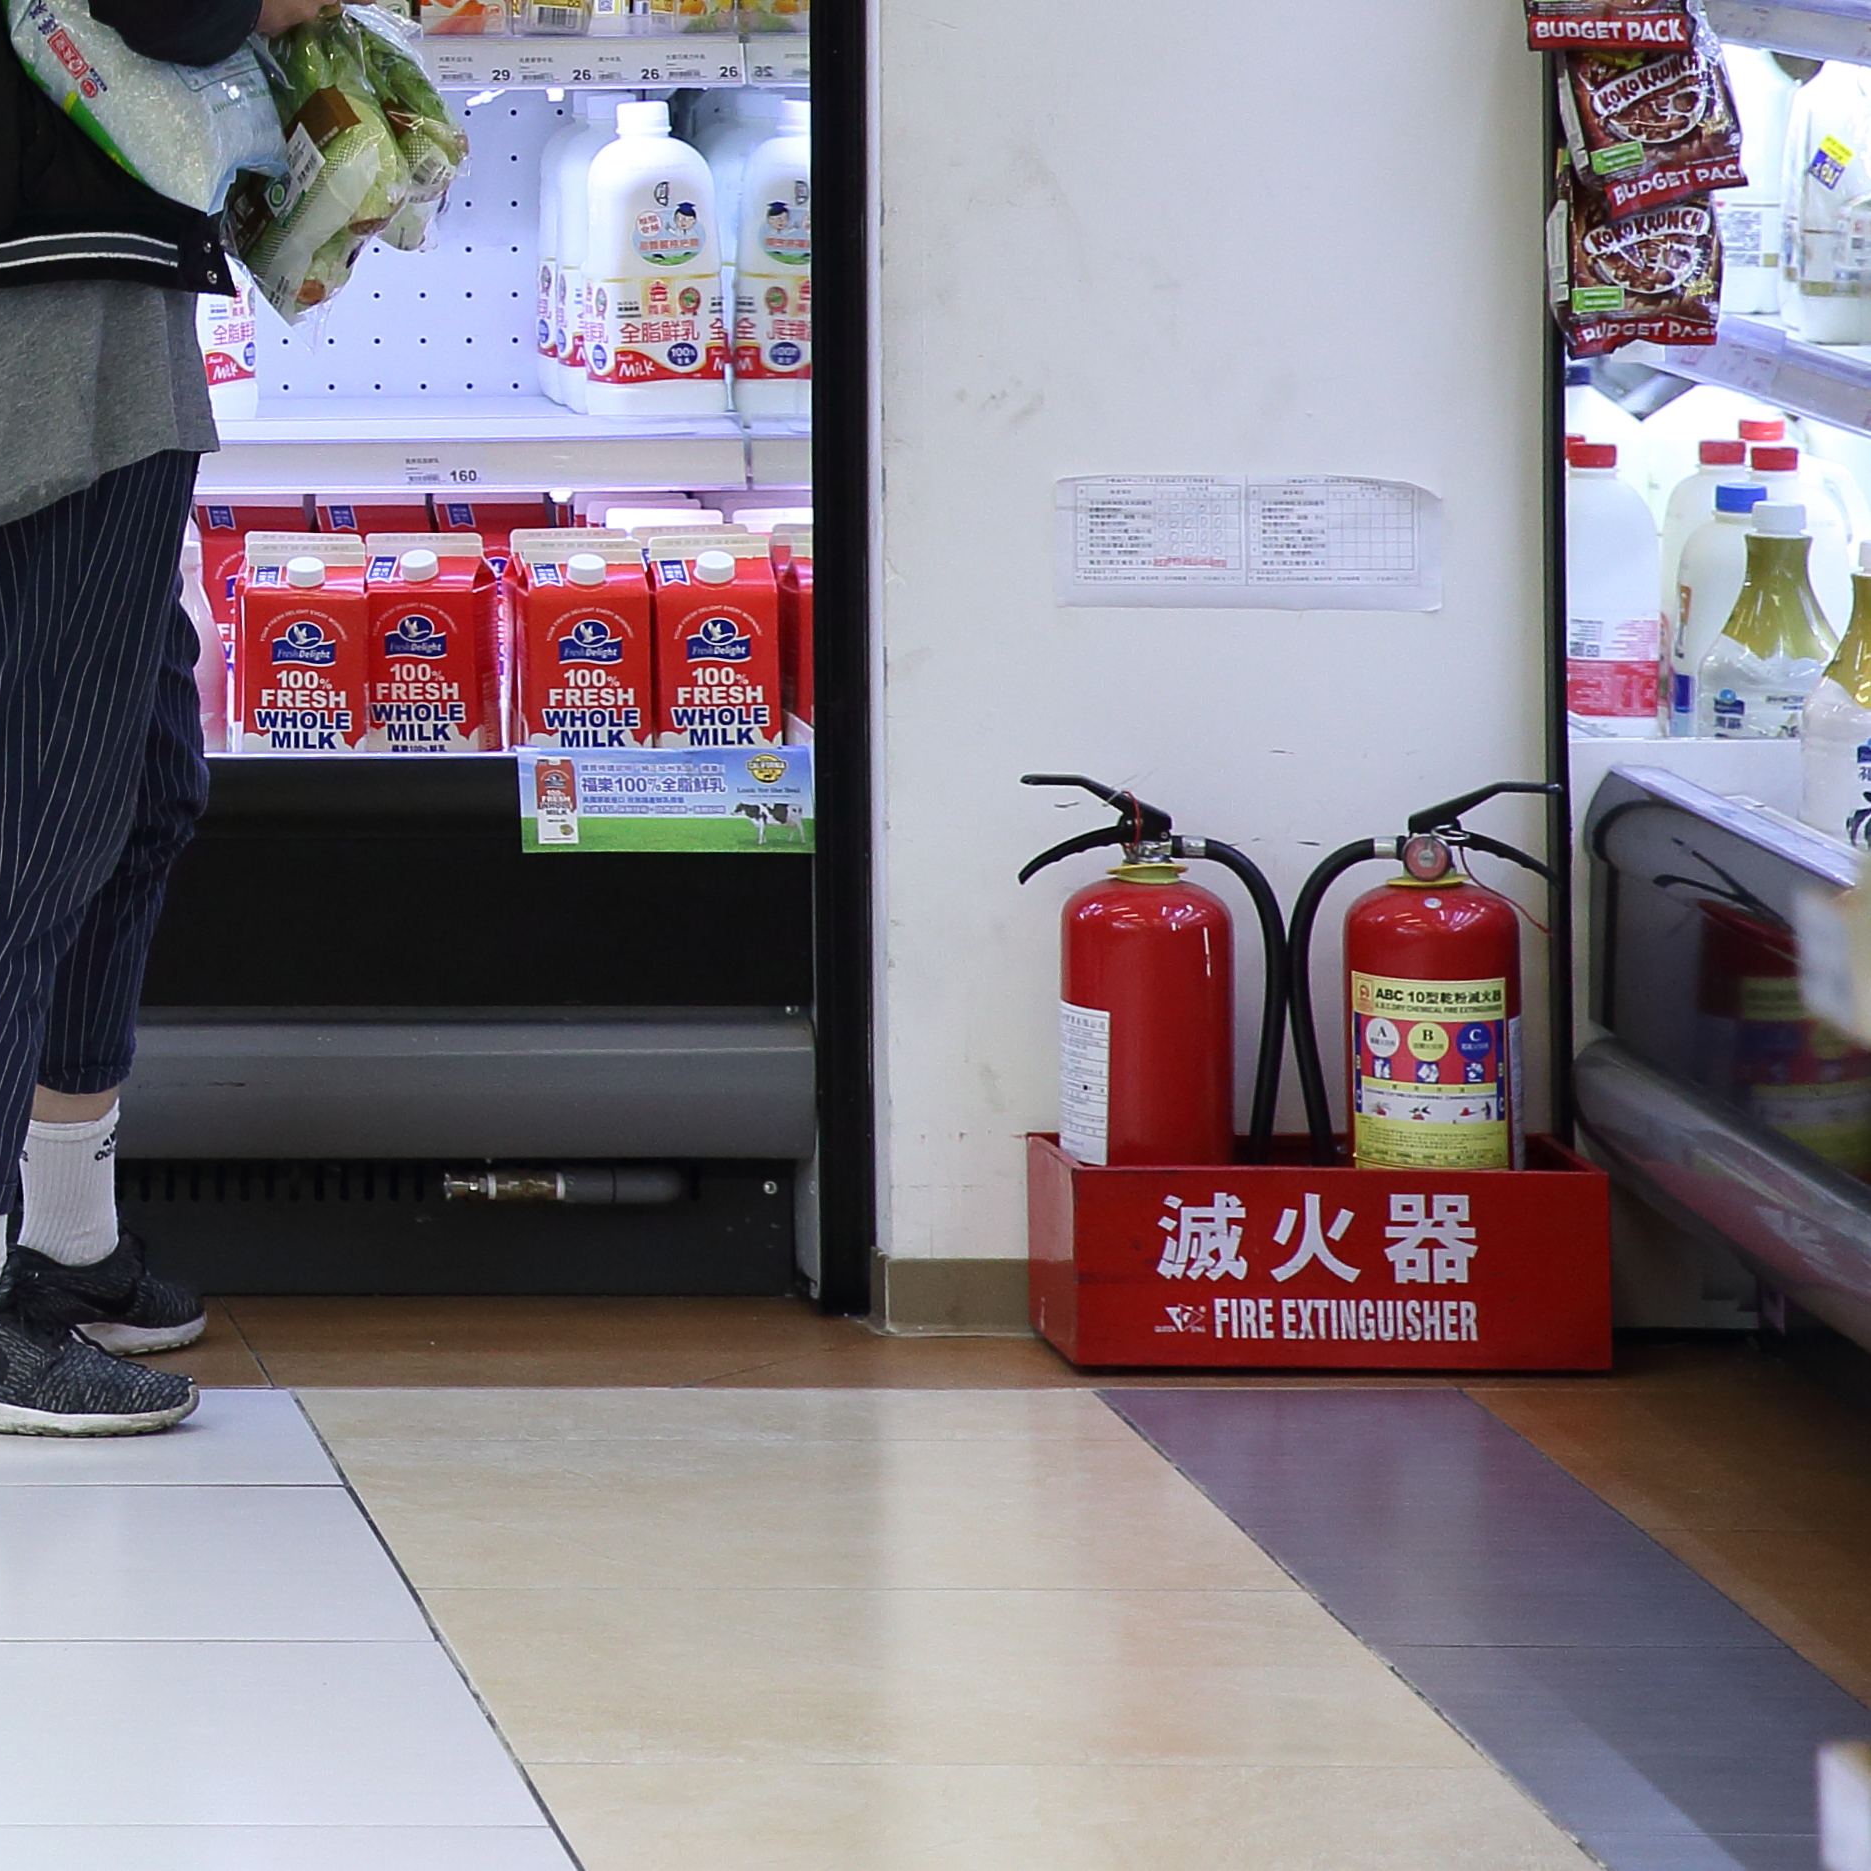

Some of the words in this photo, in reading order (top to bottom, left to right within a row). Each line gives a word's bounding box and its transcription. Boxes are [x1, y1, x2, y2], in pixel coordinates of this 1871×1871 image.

[1536, 20, 1623, 39] BUDGET
[1627, 19, 1685, 43] PACK
[492, 69, 511, 82] 29
[573, 69, 591, 81] 26
[641, 67, 659, 80] 26
[719, 65, 738, 79] 26
[1612, 170, 1691, 206] BUDGET
[619, 318, 700, 343] 全脂鮮乳
[450, 470, 477, 482] 160
[276, 670, 333, 690] 100%
[391, 663, 445, 683] 100%
[563, 668, 620, 689] 100%
[692, 666, 749, 687] 100%
[261, 688, 347, 708] FRESH
[375, 682, 460, 701] FRESH
[548, 687, 635, 707] FRESH
[676, 685, 764, 705] FRESH
[255, 710, 352, 730] WHOLE
[372, 702, 465, 723] WHOLE
[542, 708, 640, 728] WHOLE
[672, 706, 769, 726] WHOLE
[271, 730, 337, 750] MILK
[387, 722, 452, 742] MILK
[560, 729, 626, 748] MILK
[689, 727, 754, 746] MILK
[581, 778, 726, 793] 福樂100%全脂鮮乳
[1376, 988, 1404, 1001] ABC
[1408, 990, 1501, 1004] 10型乾粉滅火器
[1378, 1027, 1387, 1037] A
[1423, 1030, 1434, 1041] B
[1469, 1029, 1481, 1041] C
[1156, 1193, 1479, 1284] 滅火器
[1214, 1299, 1276, 1340] FIRE
[1282, 1299, 1479, 1342] EXTINGUISHER
